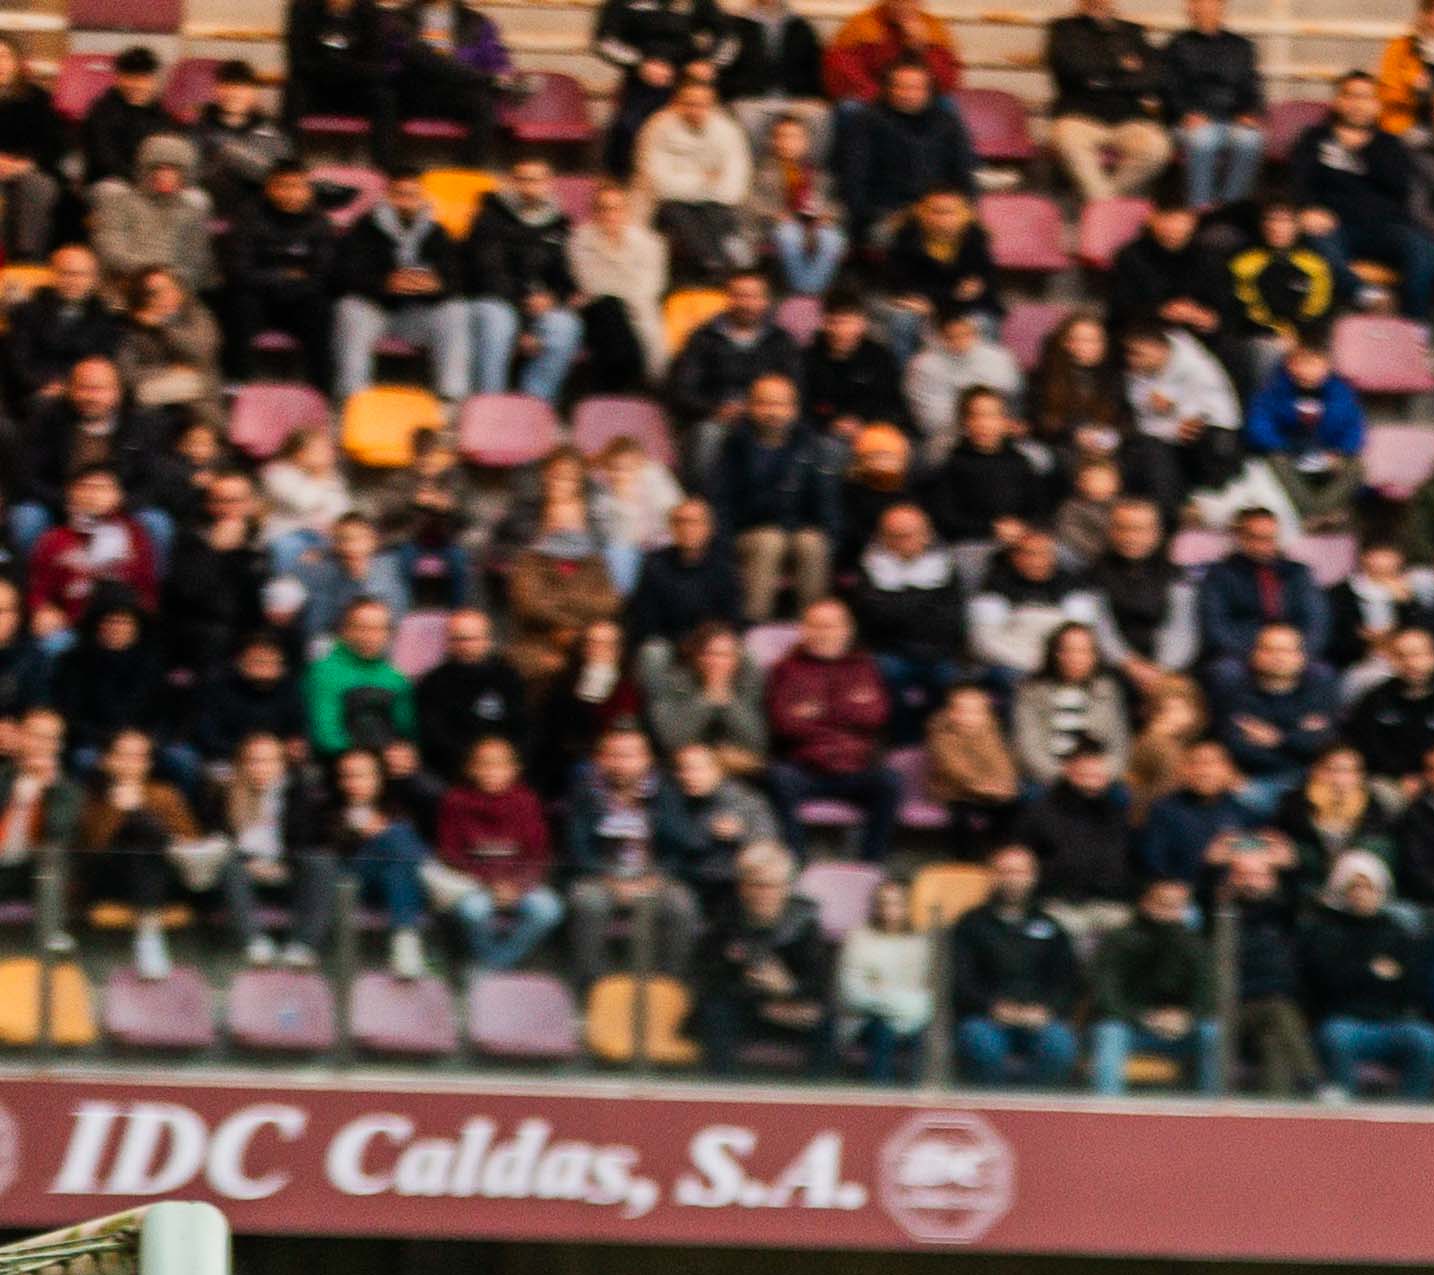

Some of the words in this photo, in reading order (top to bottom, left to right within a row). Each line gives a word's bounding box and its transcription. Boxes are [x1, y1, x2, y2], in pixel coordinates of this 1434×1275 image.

[51, 1101, 307, 1199] IDC
[325, 1113, 658, 1220] Caldas,
[676, 1124, 867, 1210] S.A.
